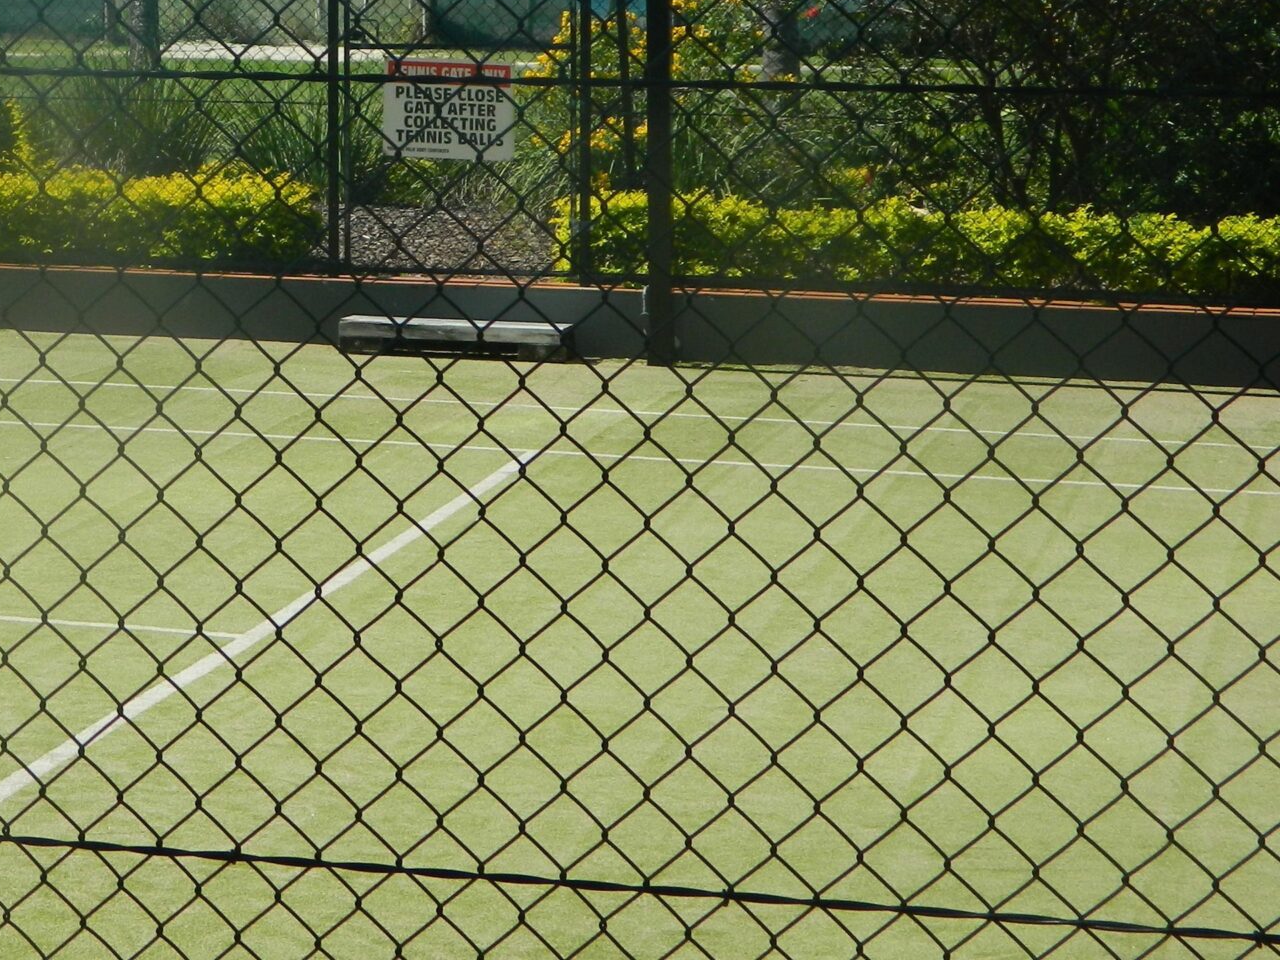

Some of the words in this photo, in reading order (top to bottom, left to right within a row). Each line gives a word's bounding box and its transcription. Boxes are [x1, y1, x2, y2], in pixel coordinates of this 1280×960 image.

[392, 64, 437, 78] ENNIS
[441, 66, 472, 79] GATE
[477, 67, 507, 80] NLY
[395, 86, 451, 100] PLEASE
[458, 88, 503, 103] CLOSE
[404, 101, 440, 114] GAT
[448, 103, 496, 117] AFTER
[404, 116, 496, 132] COLLECTING
[396, 129, 451, 144] TENNIS
[458, 133, 503, 147] BALLS
